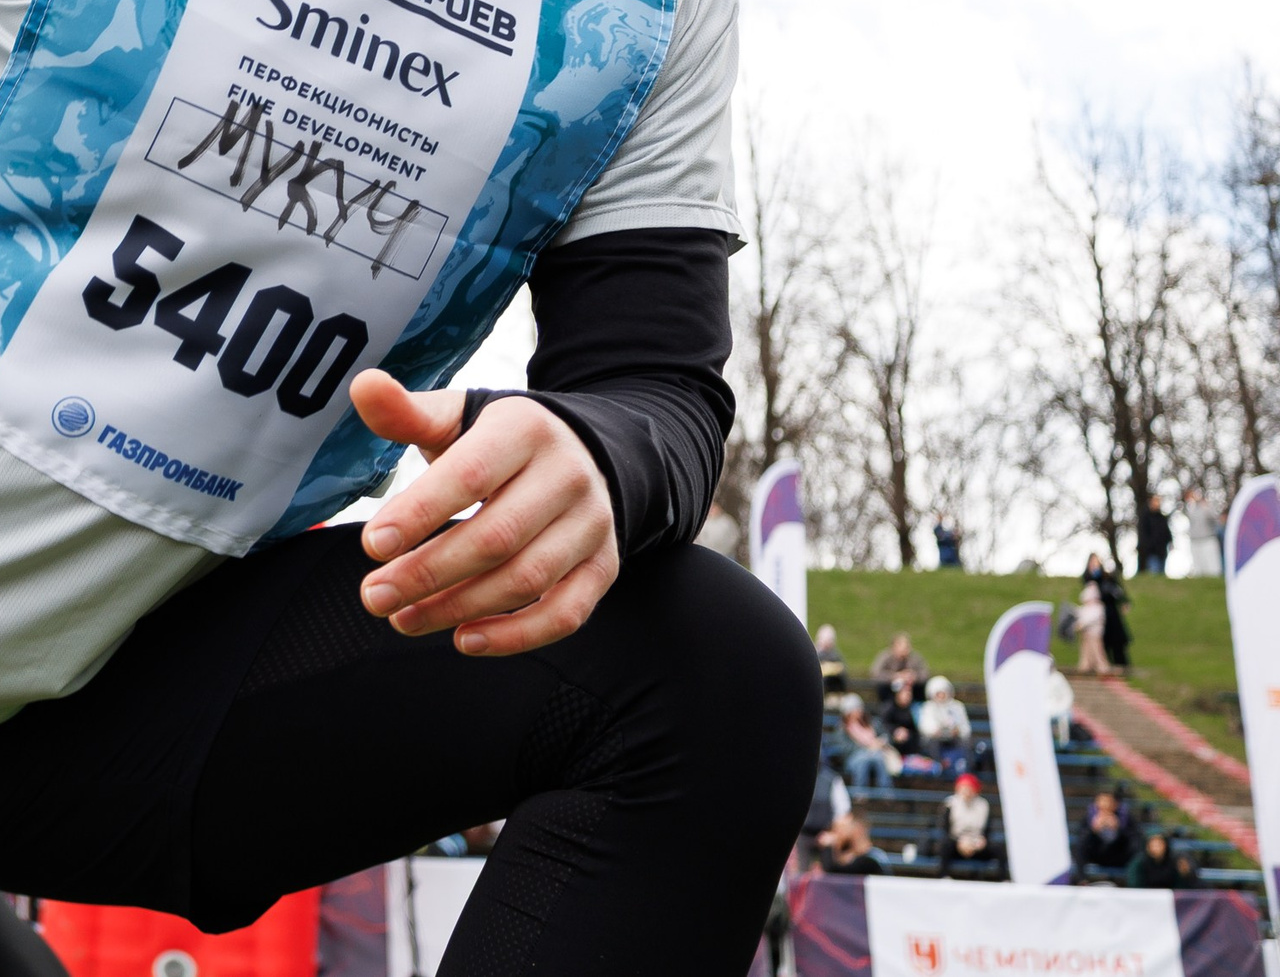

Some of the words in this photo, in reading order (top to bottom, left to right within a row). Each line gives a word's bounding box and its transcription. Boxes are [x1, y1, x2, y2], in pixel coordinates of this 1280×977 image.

[227, 84, 276, 116] FINE
[282, 108, 427, 181] DEVELOPMENT
[238, 55, 439, 155] ПЕРФЕКЦИОНИСТЫ
[82, 214, 369, 419] 5400
[97, 425, 244, 501] ГАЗПРОМБАНК
[952, 945, 1146, 976] ЧЕМПИОНАТ
